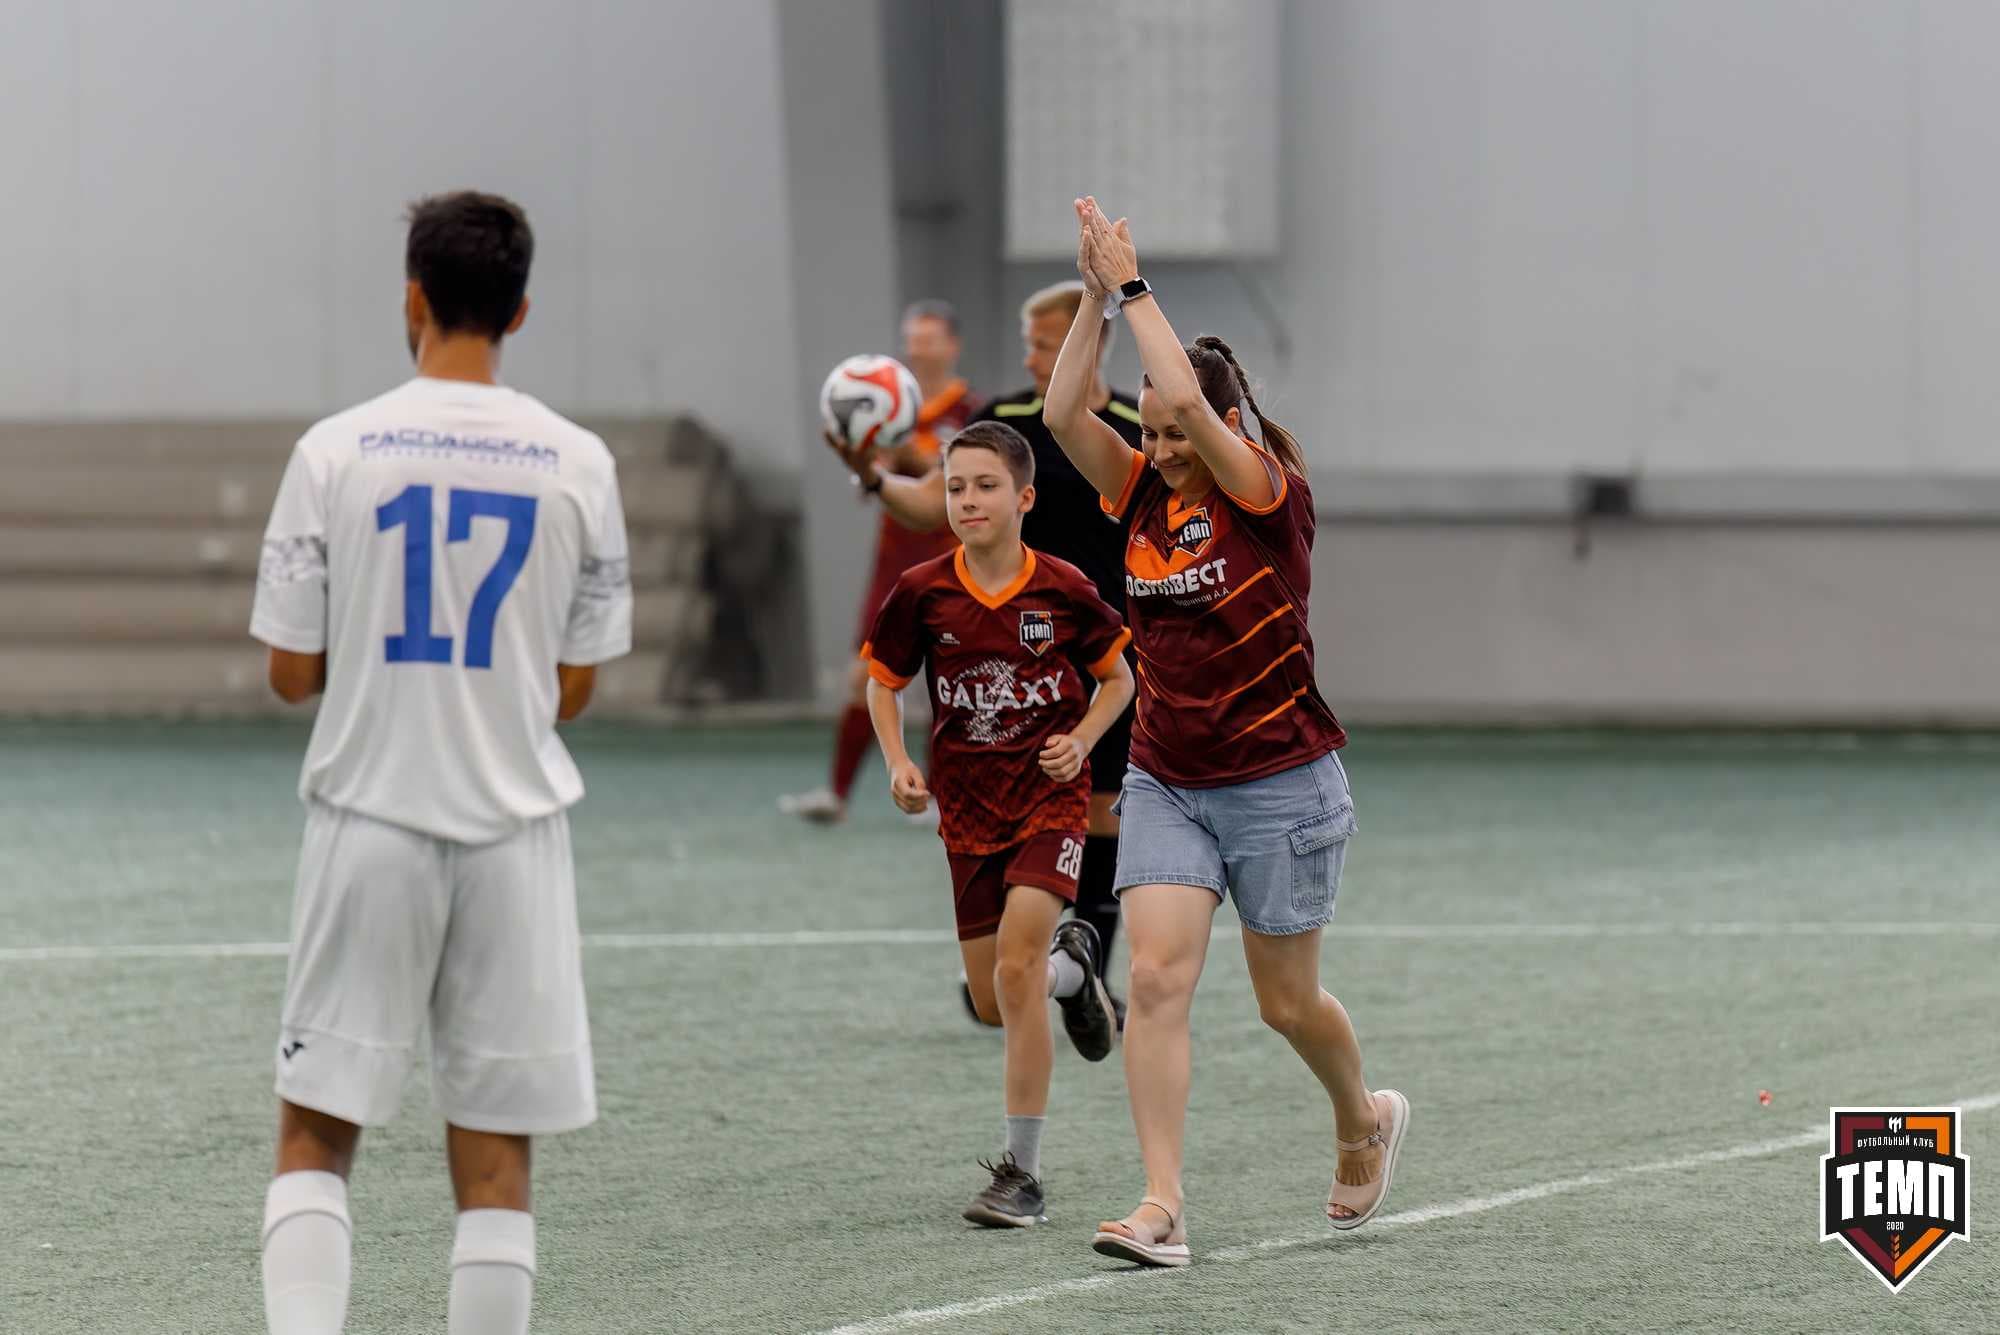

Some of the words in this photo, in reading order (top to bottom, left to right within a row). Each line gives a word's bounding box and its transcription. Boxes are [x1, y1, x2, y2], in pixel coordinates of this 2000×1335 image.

[375, 484, 538, 670] 17
[1022, 622, 1051, 641] ТЕМП
[936, 669, 1064, 711] GALAXY
[1055, 836, 1083, 881] 28
